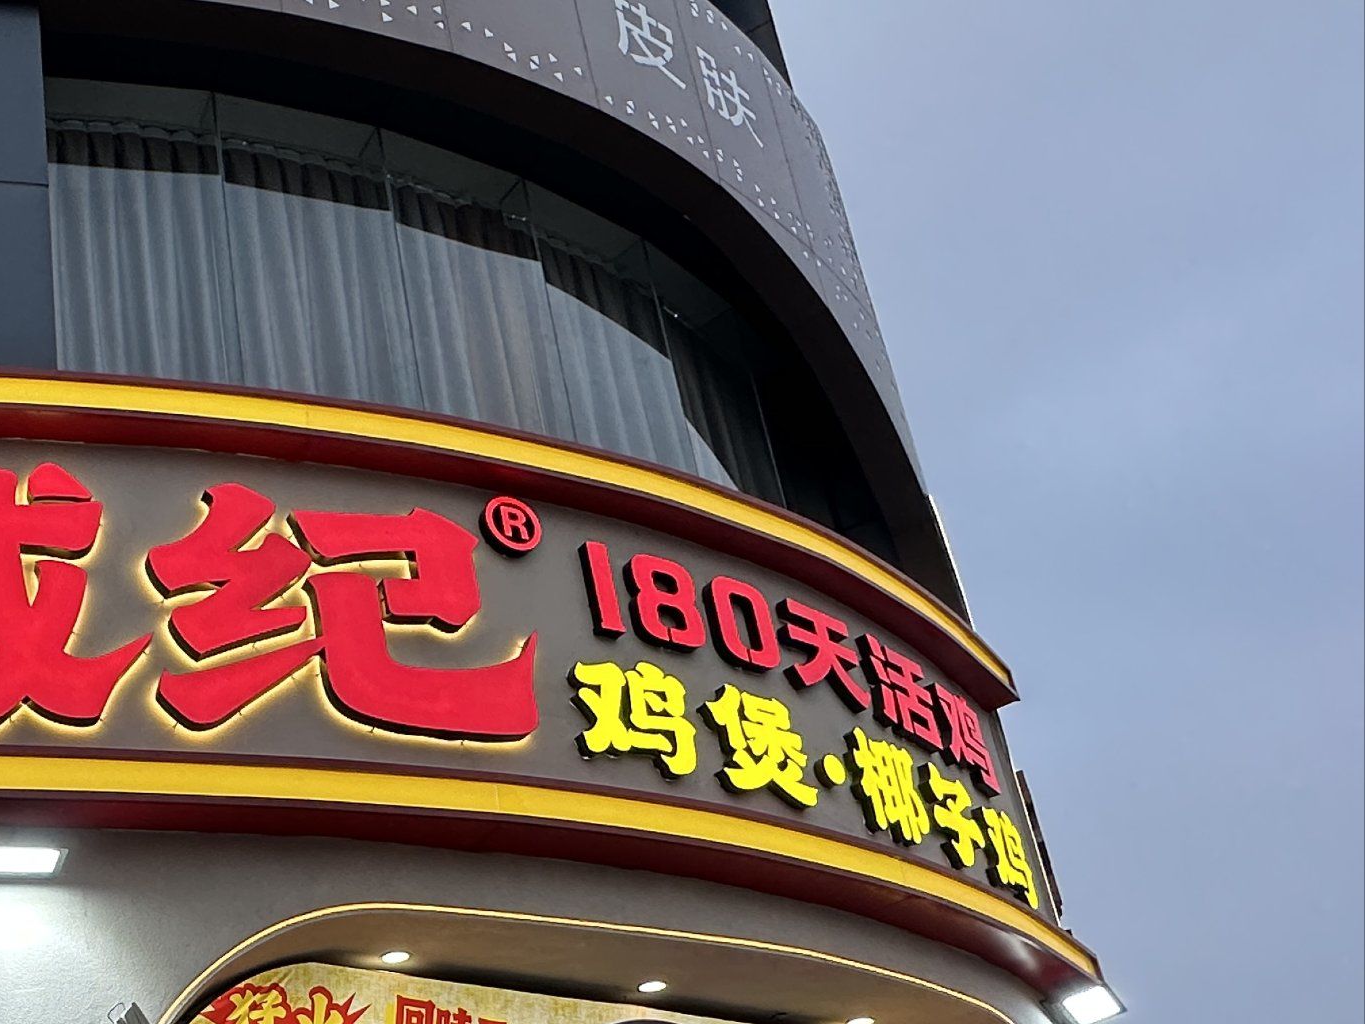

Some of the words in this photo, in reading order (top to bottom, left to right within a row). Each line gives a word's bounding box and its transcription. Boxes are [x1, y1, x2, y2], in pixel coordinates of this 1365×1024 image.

[615, 0, 765, 148] 皮肤
[581, 541, 1003, 797] 180天活鸡
